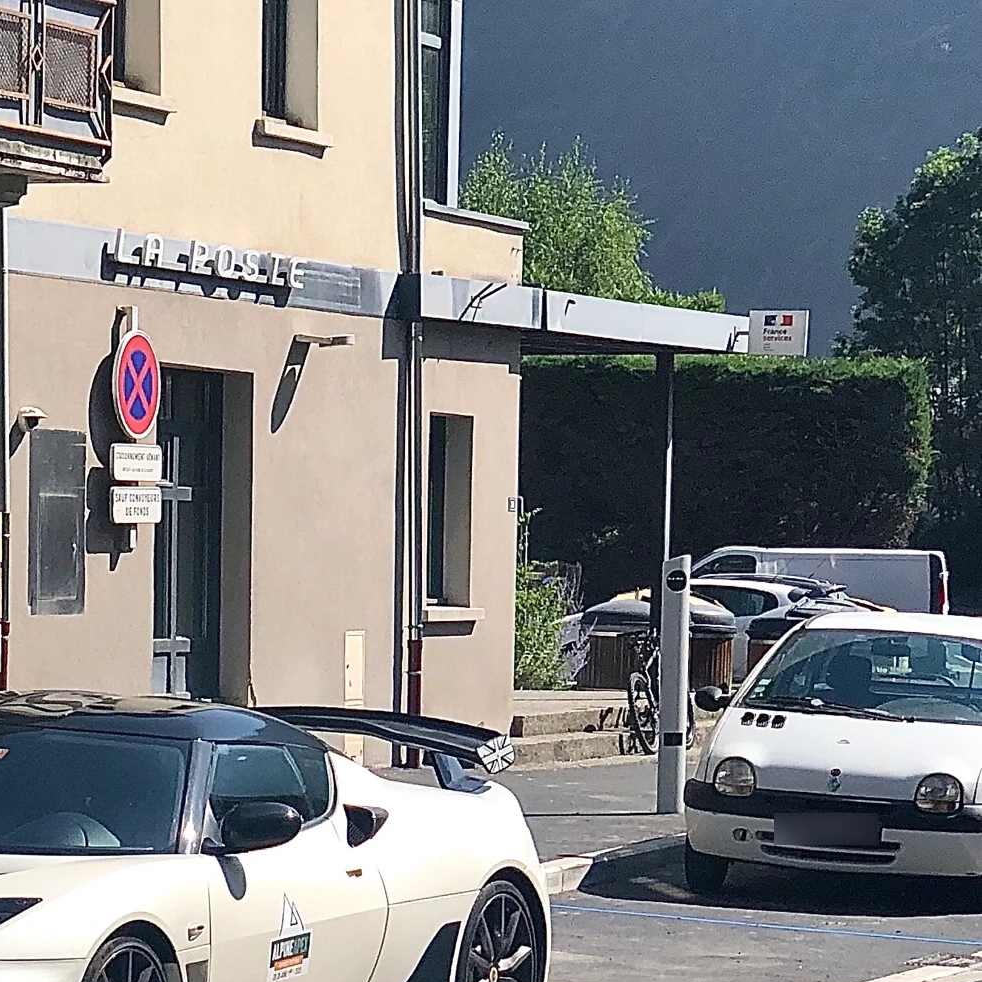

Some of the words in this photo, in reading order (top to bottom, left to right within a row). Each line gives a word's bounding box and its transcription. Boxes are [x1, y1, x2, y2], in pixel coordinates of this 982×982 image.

[115, 228, 164, 268] LA
[190, 240, 308, 289] POSTE
[115, 493, 128, 503] SAUF
[125, 506, 132, 516] DE
[133, 506, 149, 516] FONDS
